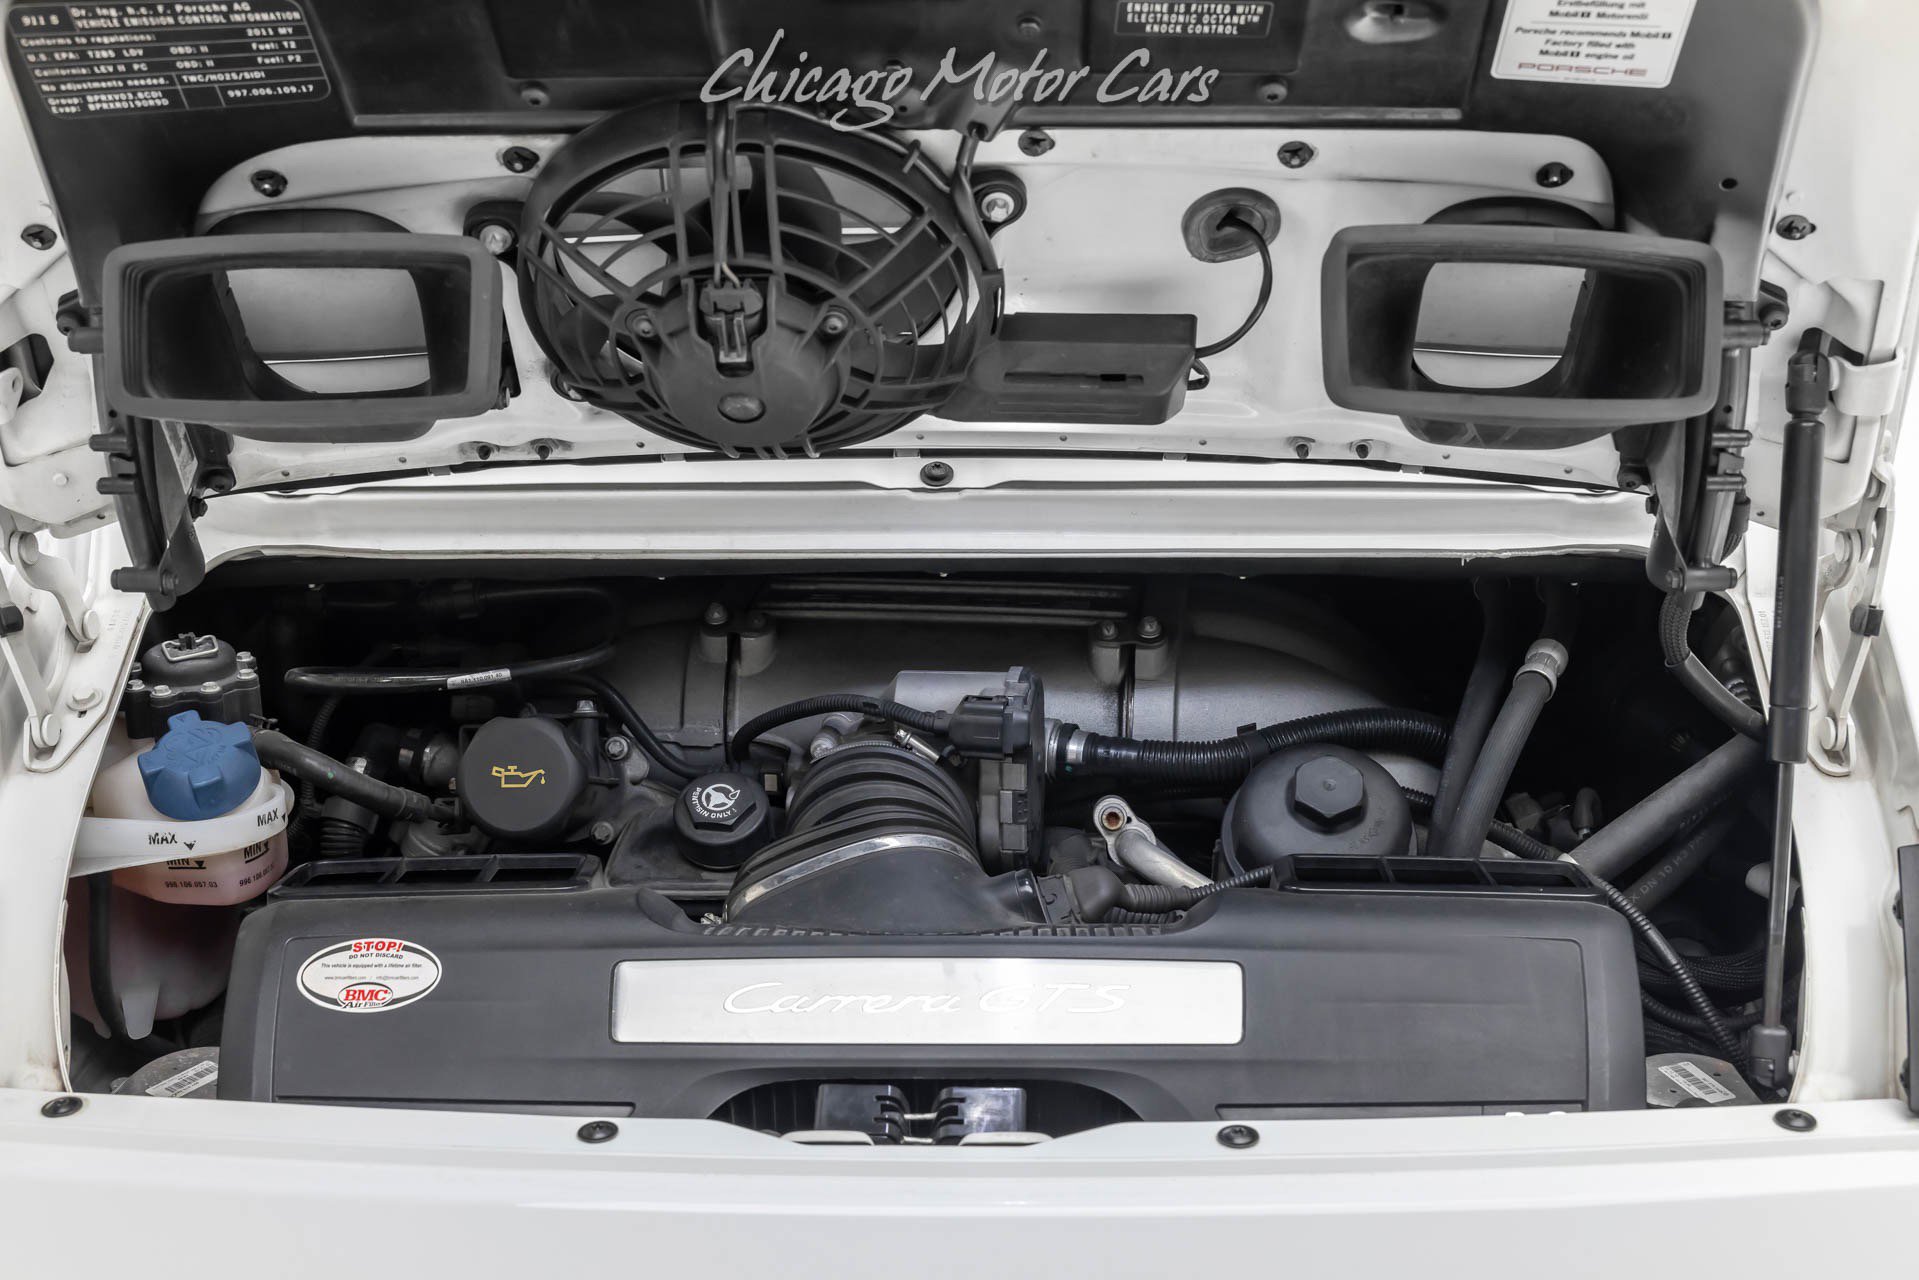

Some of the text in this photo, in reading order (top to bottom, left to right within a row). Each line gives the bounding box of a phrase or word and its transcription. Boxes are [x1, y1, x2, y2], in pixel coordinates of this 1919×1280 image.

[70, 7, 92, 17] Dr.
[96, 6, 122, 17] Ing.
[175, 3, 228, 13] Porsche
[232, 1, 251, 11] AG
[1126, 2, 1264, 14] ENGINE IS FITTED WITH
[1549, 9, 1578, 17] Mobil
[21, 15, 46, 26] 911
[75, 11, 301, 29] VEHICLE EMISSION CONTROL INFORMATION
[1126, 13, 1197, 24] ELECTRONIC
[246, 26, 294, 37] 2011 MY
[1145, 24, 1239, 35] KNOCK CONTROL
[1514, 26, 1557, 35] Porsche
[1560, 29, 1627, 38] recommends
[1630, 31, 1659, 39] Mobil
[20, 37, 72, 47] Conforms
[75, 36, 87, 44] to
[251, 42, 279, 51] Fuel:
[1544, 39, 1584, 49] Factory
[1539, 49, 1569, 57] Mobil
[257, 56, 285, 64] Fuel:
[1517, 62, 1648, 77] PORSCHE
[40, 77, 169, 92] No adjustments needed.
[47, 96, 83, 106] Group:
[257, 807, 279, 828] MAX
[148, 832, 178, 846] MAX
[243, 840, 262, 860] MIN
[353, 941, 405, 953] STOP!
[375, 952, 404, 960] DISCARD
[343, 989, 389, 1002] BMC
[722, 982, 1131, 1015] Carrera GTS
[342, 1001, 363, 1009] Air
